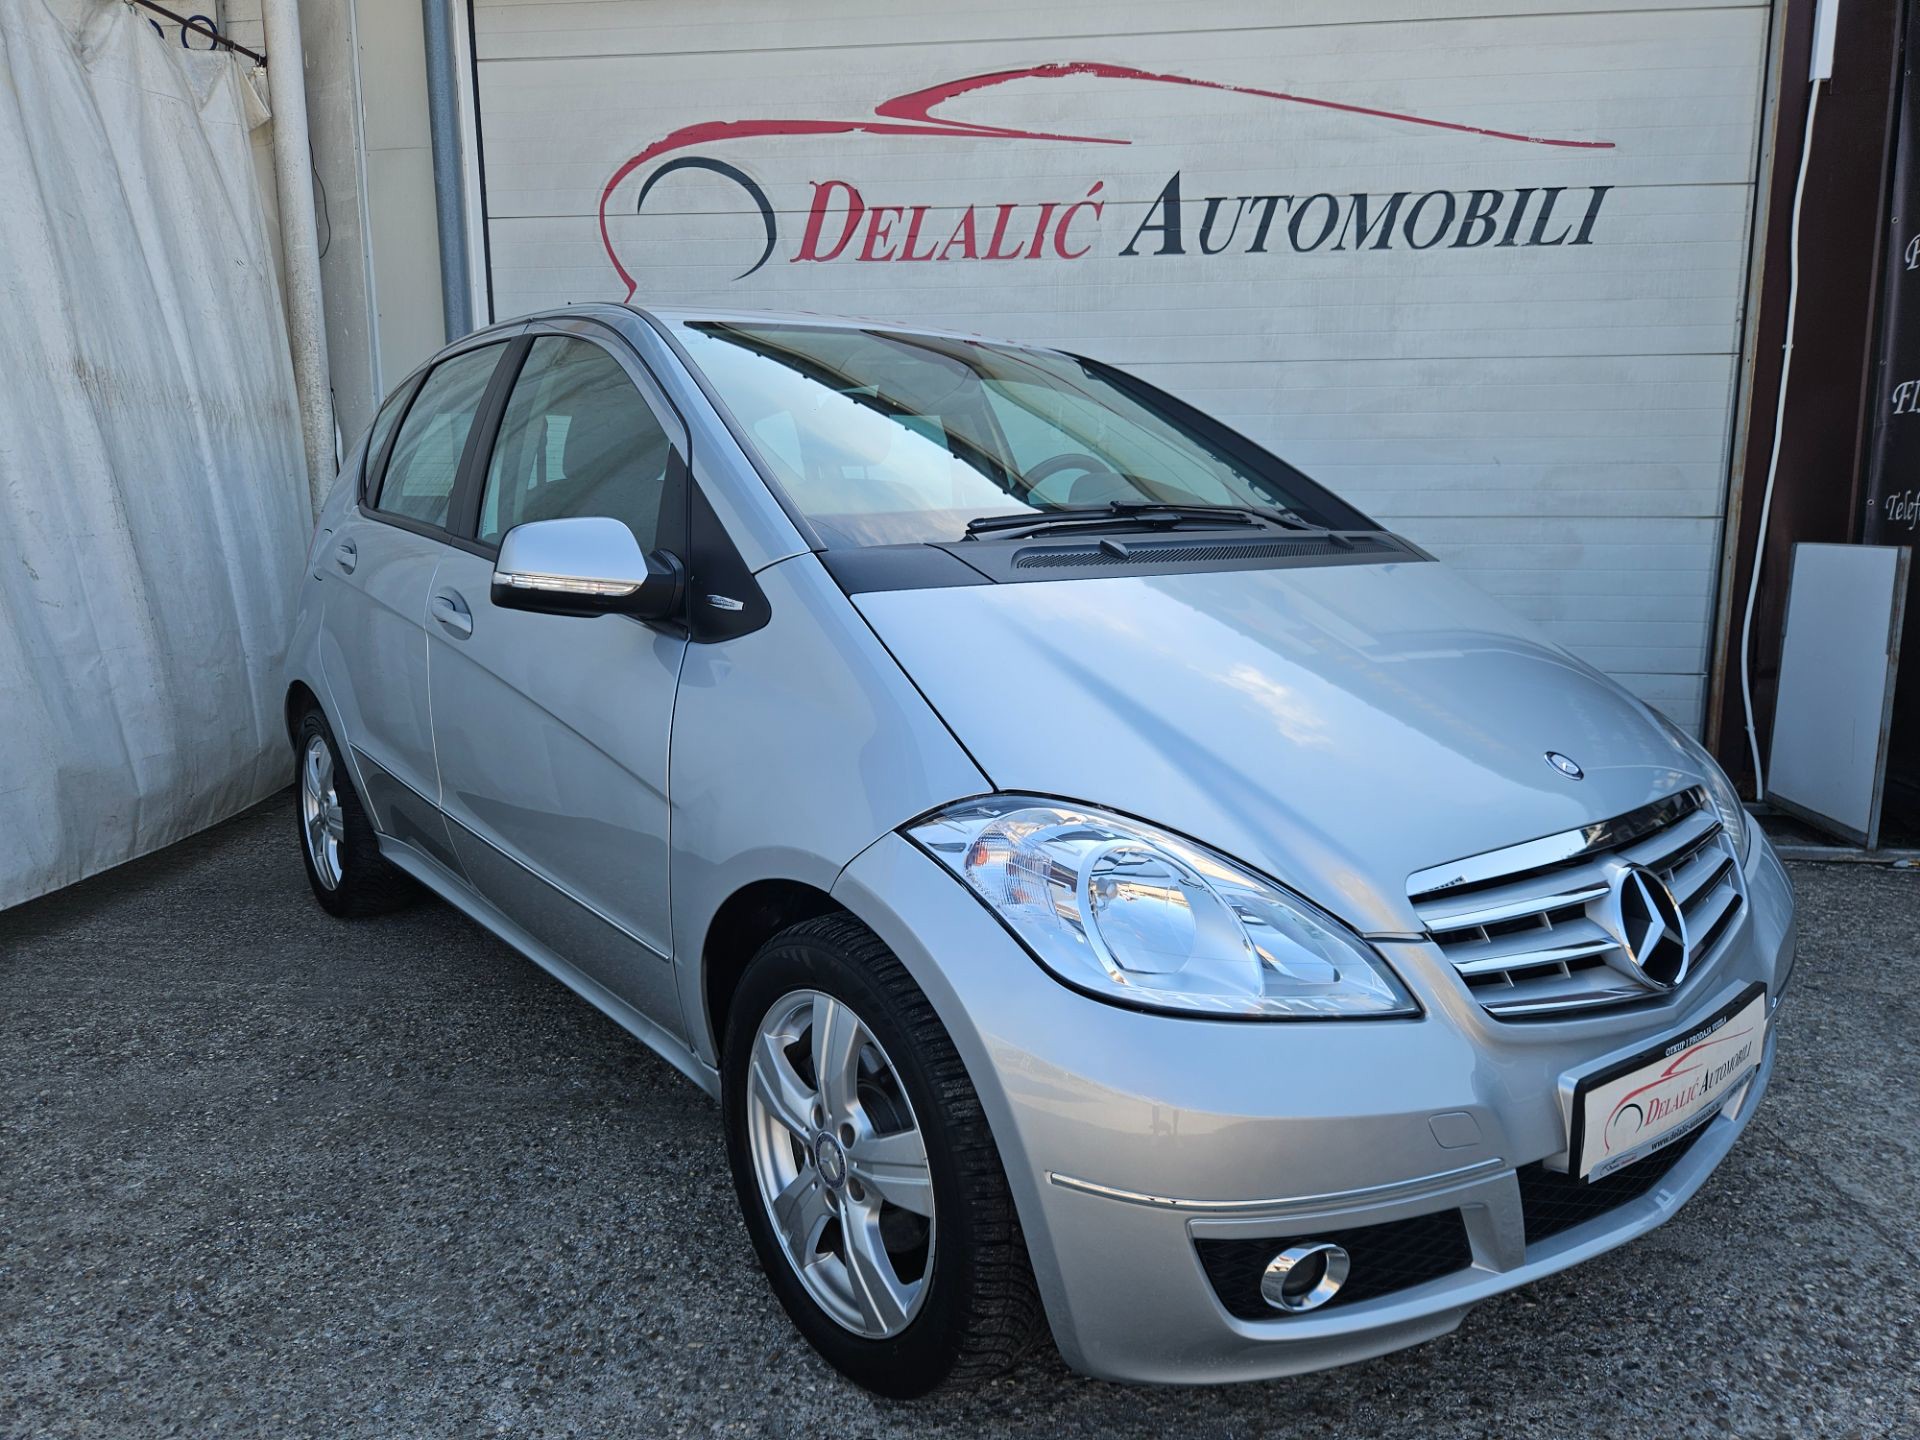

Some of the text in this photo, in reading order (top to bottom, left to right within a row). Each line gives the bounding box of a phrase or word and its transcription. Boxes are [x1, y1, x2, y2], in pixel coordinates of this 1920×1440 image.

[790, 170, 1615, 263] DELALIĆ AUTOMOBILI
[1885, 490, 1920, 531] Telef
